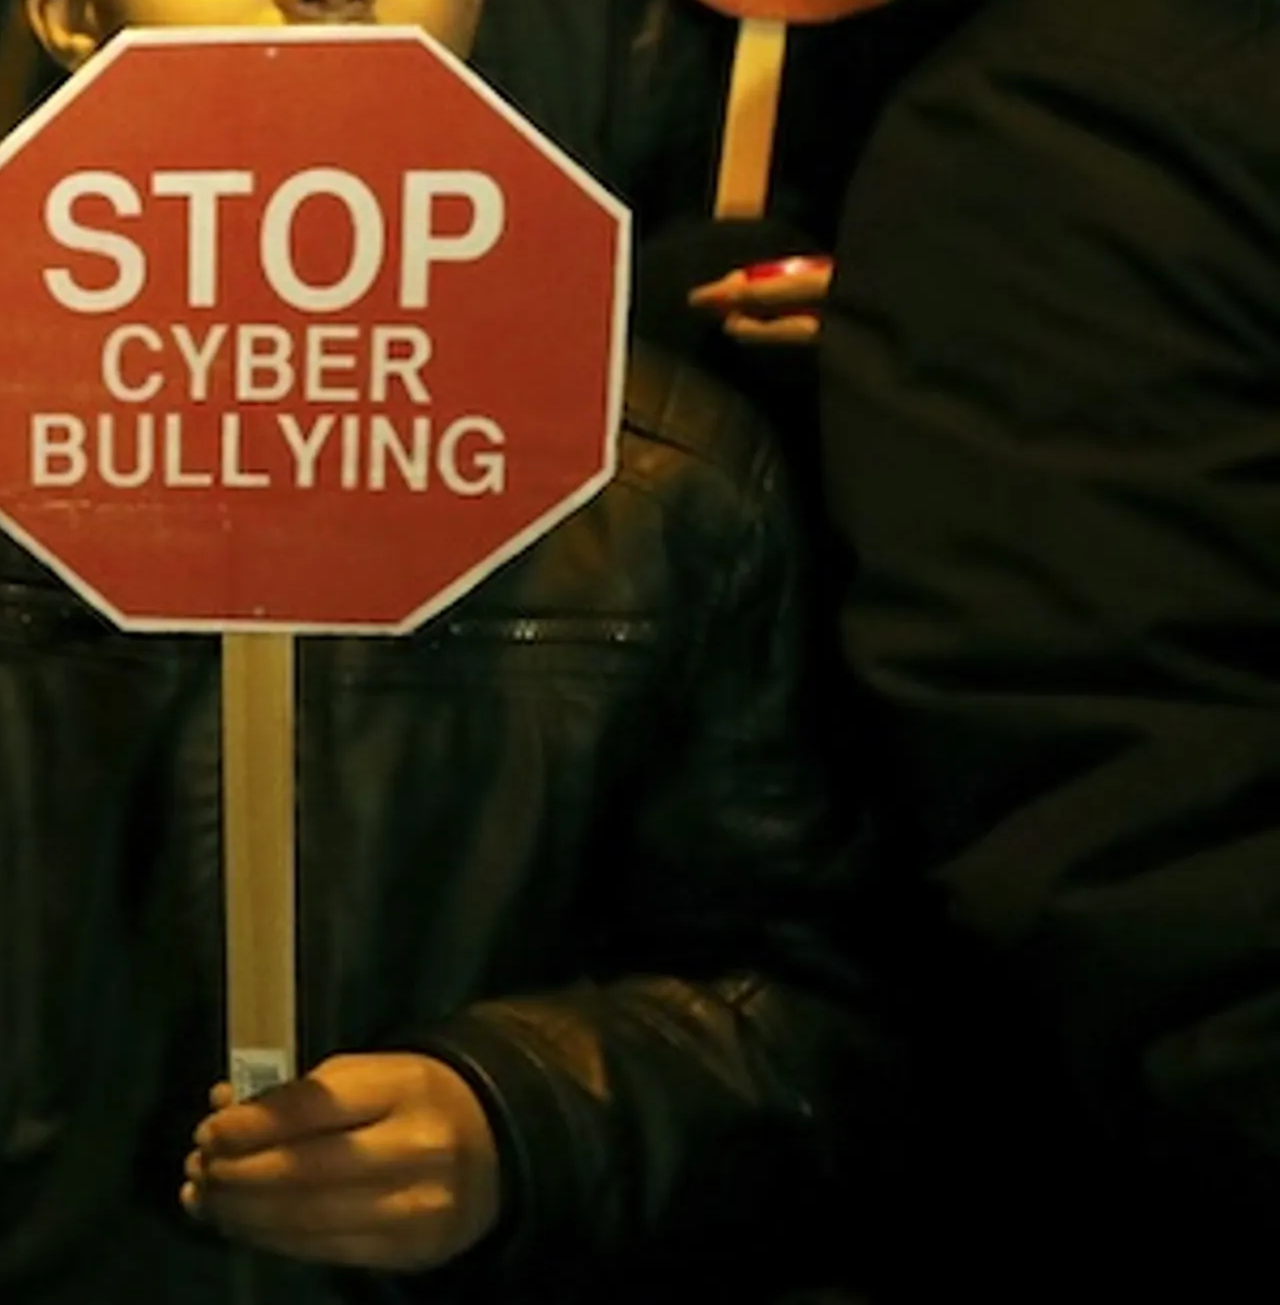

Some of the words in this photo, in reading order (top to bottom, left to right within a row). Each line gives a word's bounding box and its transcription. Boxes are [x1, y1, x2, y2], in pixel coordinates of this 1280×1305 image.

[42, 167, 507, 314] STOP
[100, 323, 432, 404] CYBER
[29, 411, 507, 495] BULLYING
